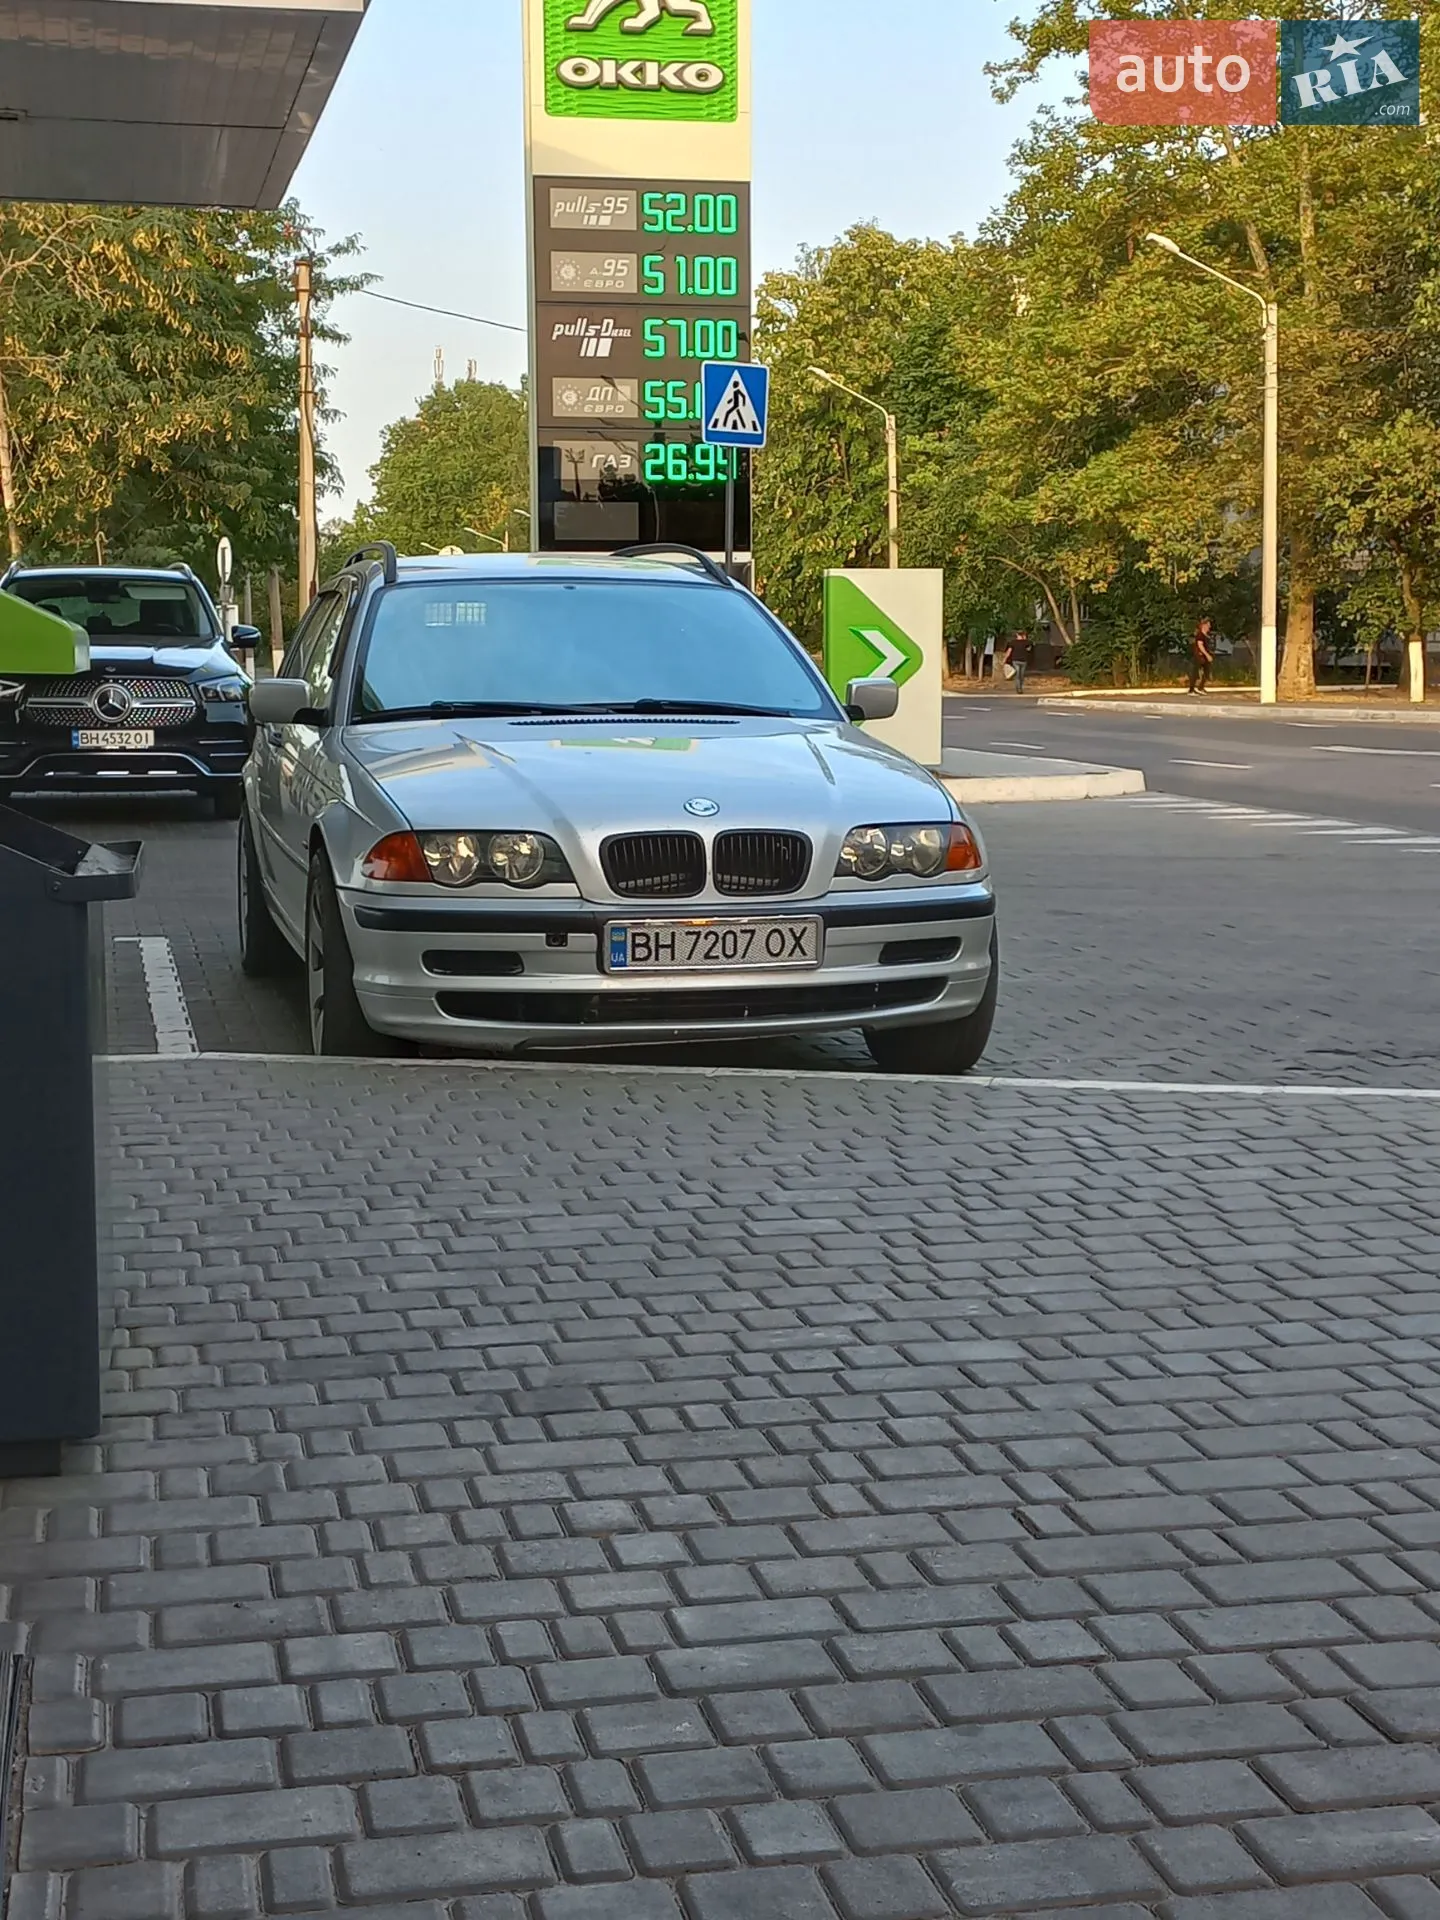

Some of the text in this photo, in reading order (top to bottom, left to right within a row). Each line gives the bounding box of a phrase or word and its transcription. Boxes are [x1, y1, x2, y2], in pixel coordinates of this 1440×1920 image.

[557, 55, 725, 93] OKKO
[642, 191, 738, 234] 52.00
[642, 317, 738, 359] 57.00
[591, 454, 633, 468] ГАЗ
[80, 732, 99, 745] BH
[101, 732, 132, 745] 4532
[611, 951, 625, 963] UA
[631, 926, 809, 963] BH 7207 OX
